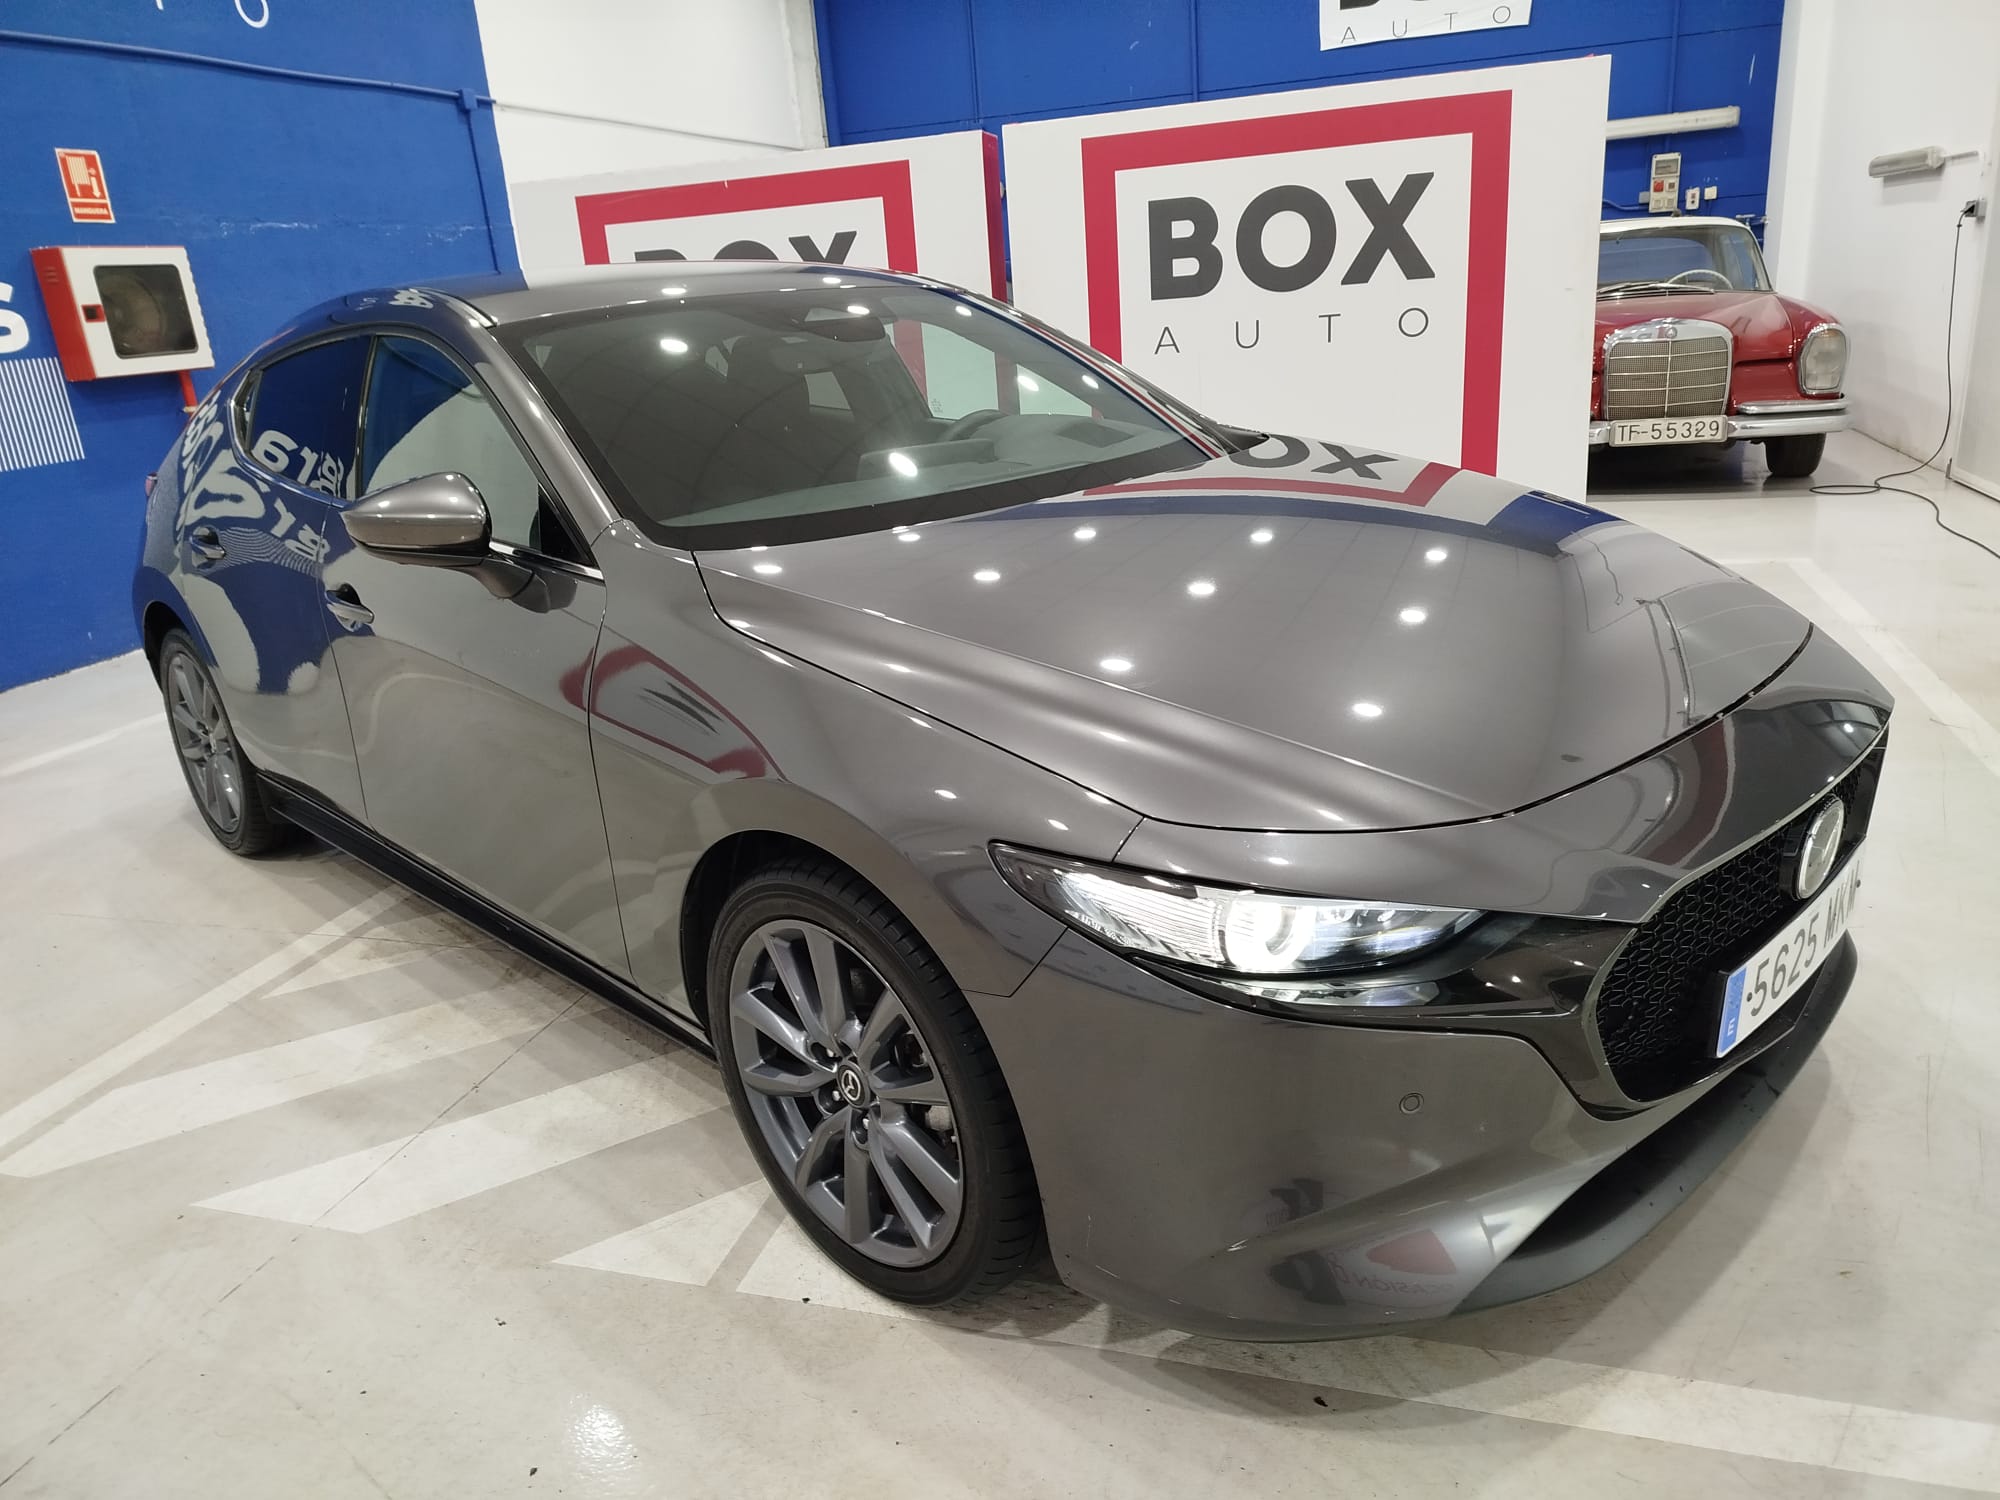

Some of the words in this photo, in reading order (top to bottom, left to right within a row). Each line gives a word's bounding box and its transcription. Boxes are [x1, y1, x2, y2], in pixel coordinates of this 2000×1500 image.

[1341, 6, 1511, 43] AUTO
[1148, 171, 1435, 300] BOX
[1154, 307, 1429, 354] AUTO
[1618, 420, 1720, 442] TF-55329
[1750, 912, 1820, 1017] 5625
